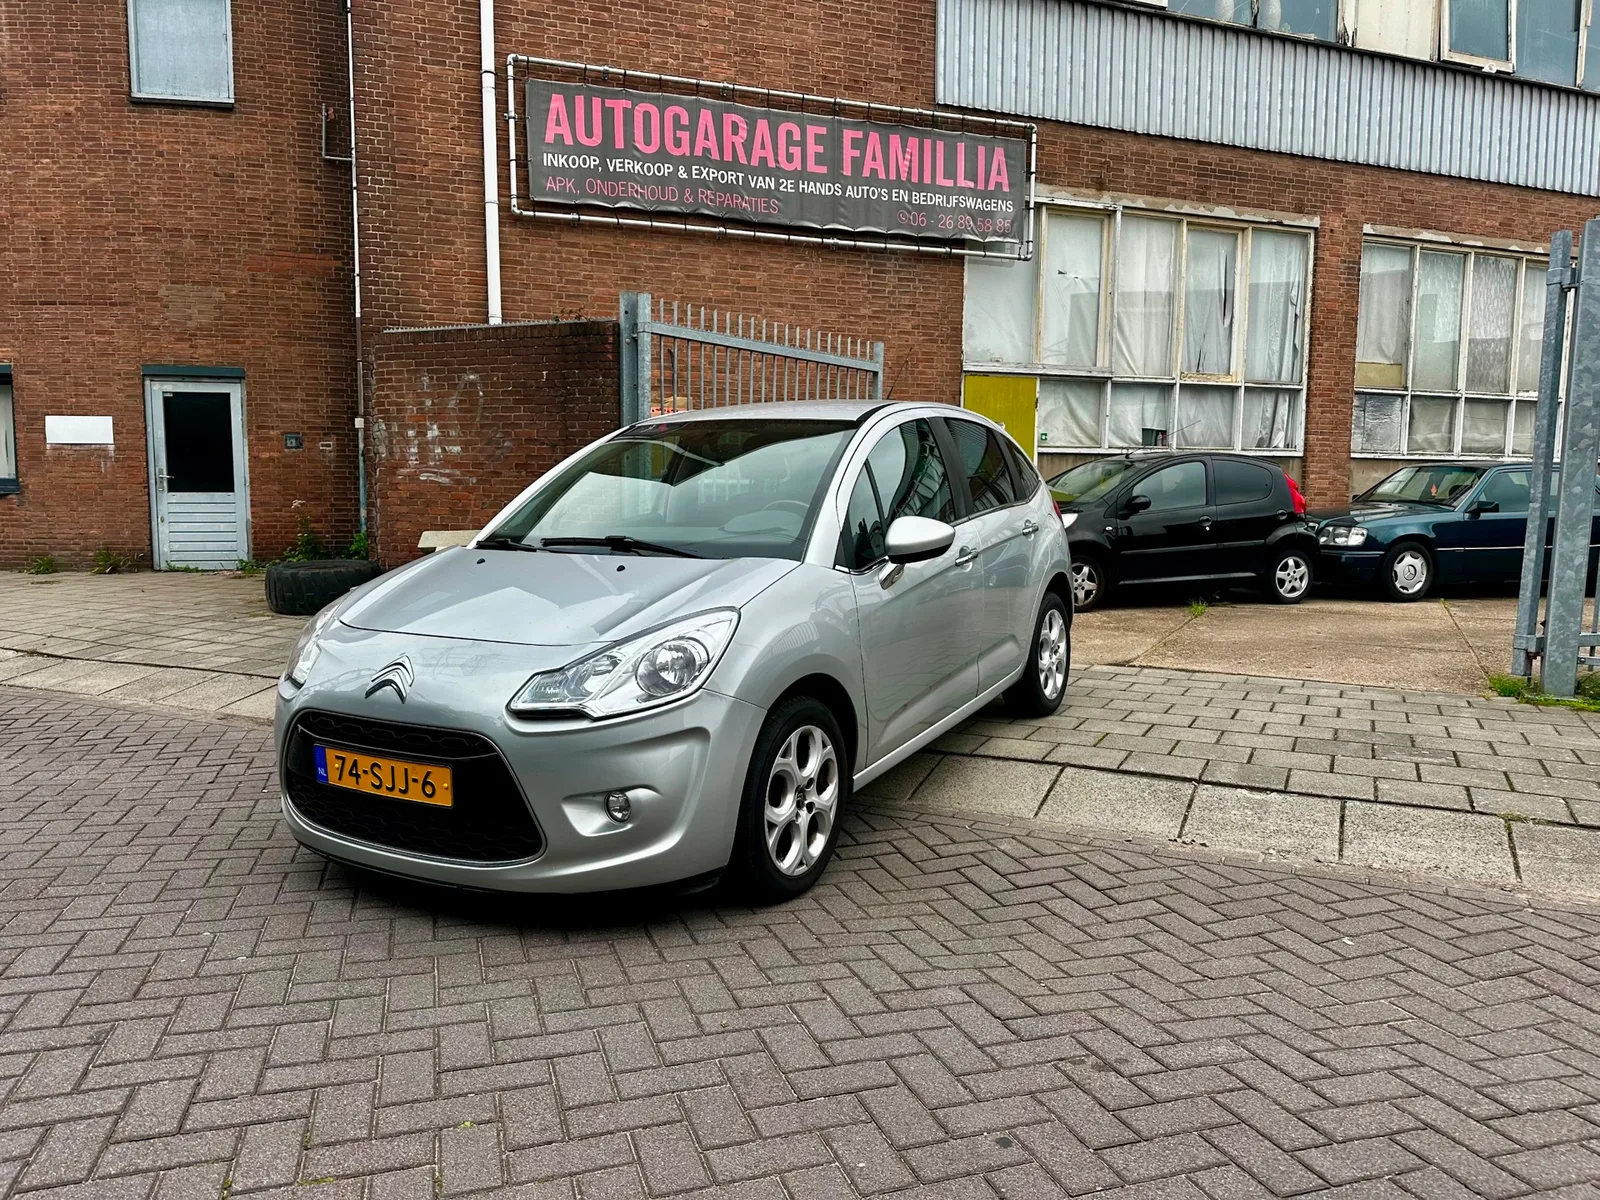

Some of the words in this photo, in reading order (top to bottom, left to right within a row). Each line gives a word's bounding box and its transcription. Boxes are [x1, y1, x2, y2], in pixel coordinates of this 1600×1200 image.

[544, 93, 828, 174] AUTOGARAGE
[842, 128, 1010, 192] FAMILLIA
[543, 152, 602, 172] INKOOP,
[606, 158, 673, 178] VERKOOP
[677, 166, 688, 179] &
[692, 166, 744, 186] EXPORT
[748, 174, 775, 190] VAN
[779, 178, 795, 193] 2E
[799, 180, 842, 197] HANDS
[845, 185, 888, 201] AUTO'S
[892, 189, 908, 203] EN
[912, 192, 1014, 213] BEDRIJFSWAGENS
[546, 176, 580, 196] APK,
[585, 178, 679, 202] ONDERHOUD
[683, 189, 694, 204] &
[698, 189, 779, 215] REPARATIES
[910, 211, 927, 227] 06
[938, 214, 954, 229] 26
[318, 767, 327, 777] NL
[334, 754, 437, 798] 74-SJJ-6
